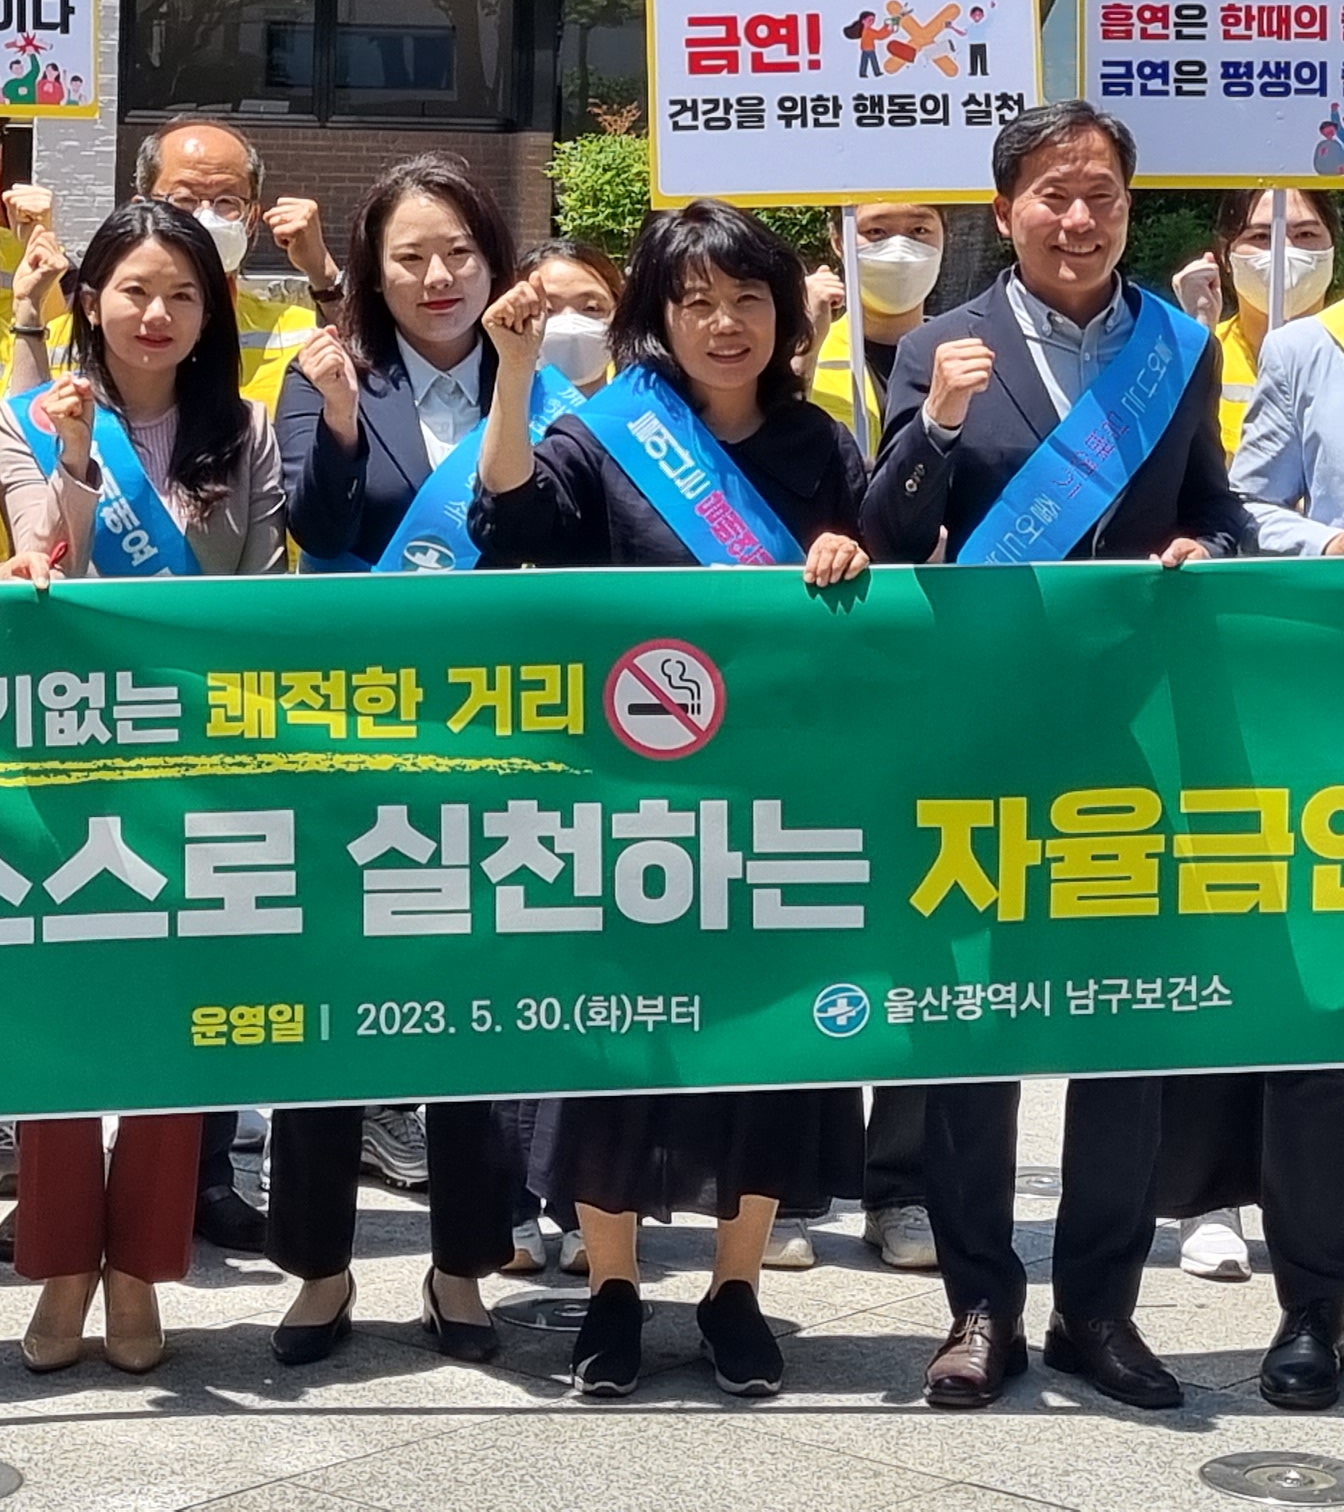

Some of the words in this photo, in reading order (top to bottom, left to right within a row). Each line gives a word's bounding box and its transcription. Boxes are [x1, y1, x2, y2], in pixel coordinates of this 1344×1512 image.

[685, 12, 821, 75] 금연!
[1100, 2, 1208, 41] 흡연은
[1220, 2, 1328, 41] 한때의
[1100, 60, 1208, 98] 금연은
[1220, 60, 1328, 98] 평생의
[668, 96, 766, 130] 건강을
[776, 94, 842, 129] 위한
[852, 93, 950, 127] 행동의
[960, 91, 1025, 126] 실천
[206, 665, 424, 741] 쾌적한
[446, 663, 585, 737] 거리
[346, 799, 871, 938] 실천하는
[191, 1003, 306, 1048] 운영일
[355, 1002, 456, 1037] 2023.
[470, 999, 504, 1033] 5.
[883, 982, 1052, 1026] 울산광역시
[1066, 974, 1234, 1016] 남구보건소
